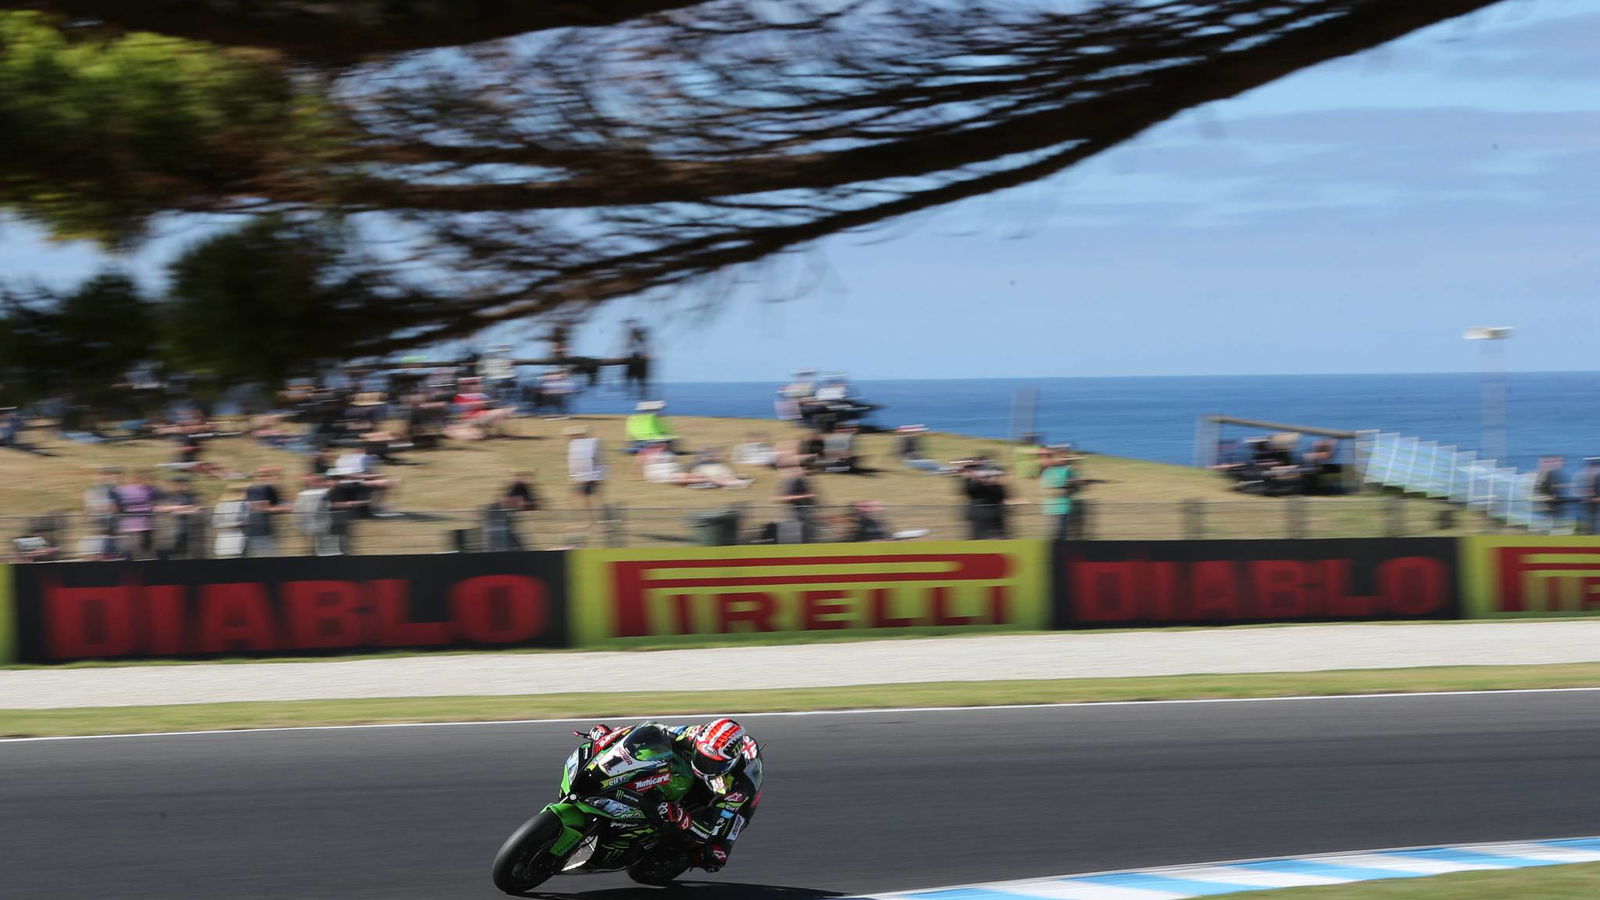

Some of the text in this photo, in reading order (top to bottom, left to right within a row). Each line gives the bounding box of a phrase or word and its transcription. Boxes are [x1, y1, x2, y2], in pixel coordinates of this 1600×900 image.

[46, 574, 548, 657] DIABLO
[612, 553, 1016, 637] PIRELLI
[1070, 556, 1446, 621] DIABLO
